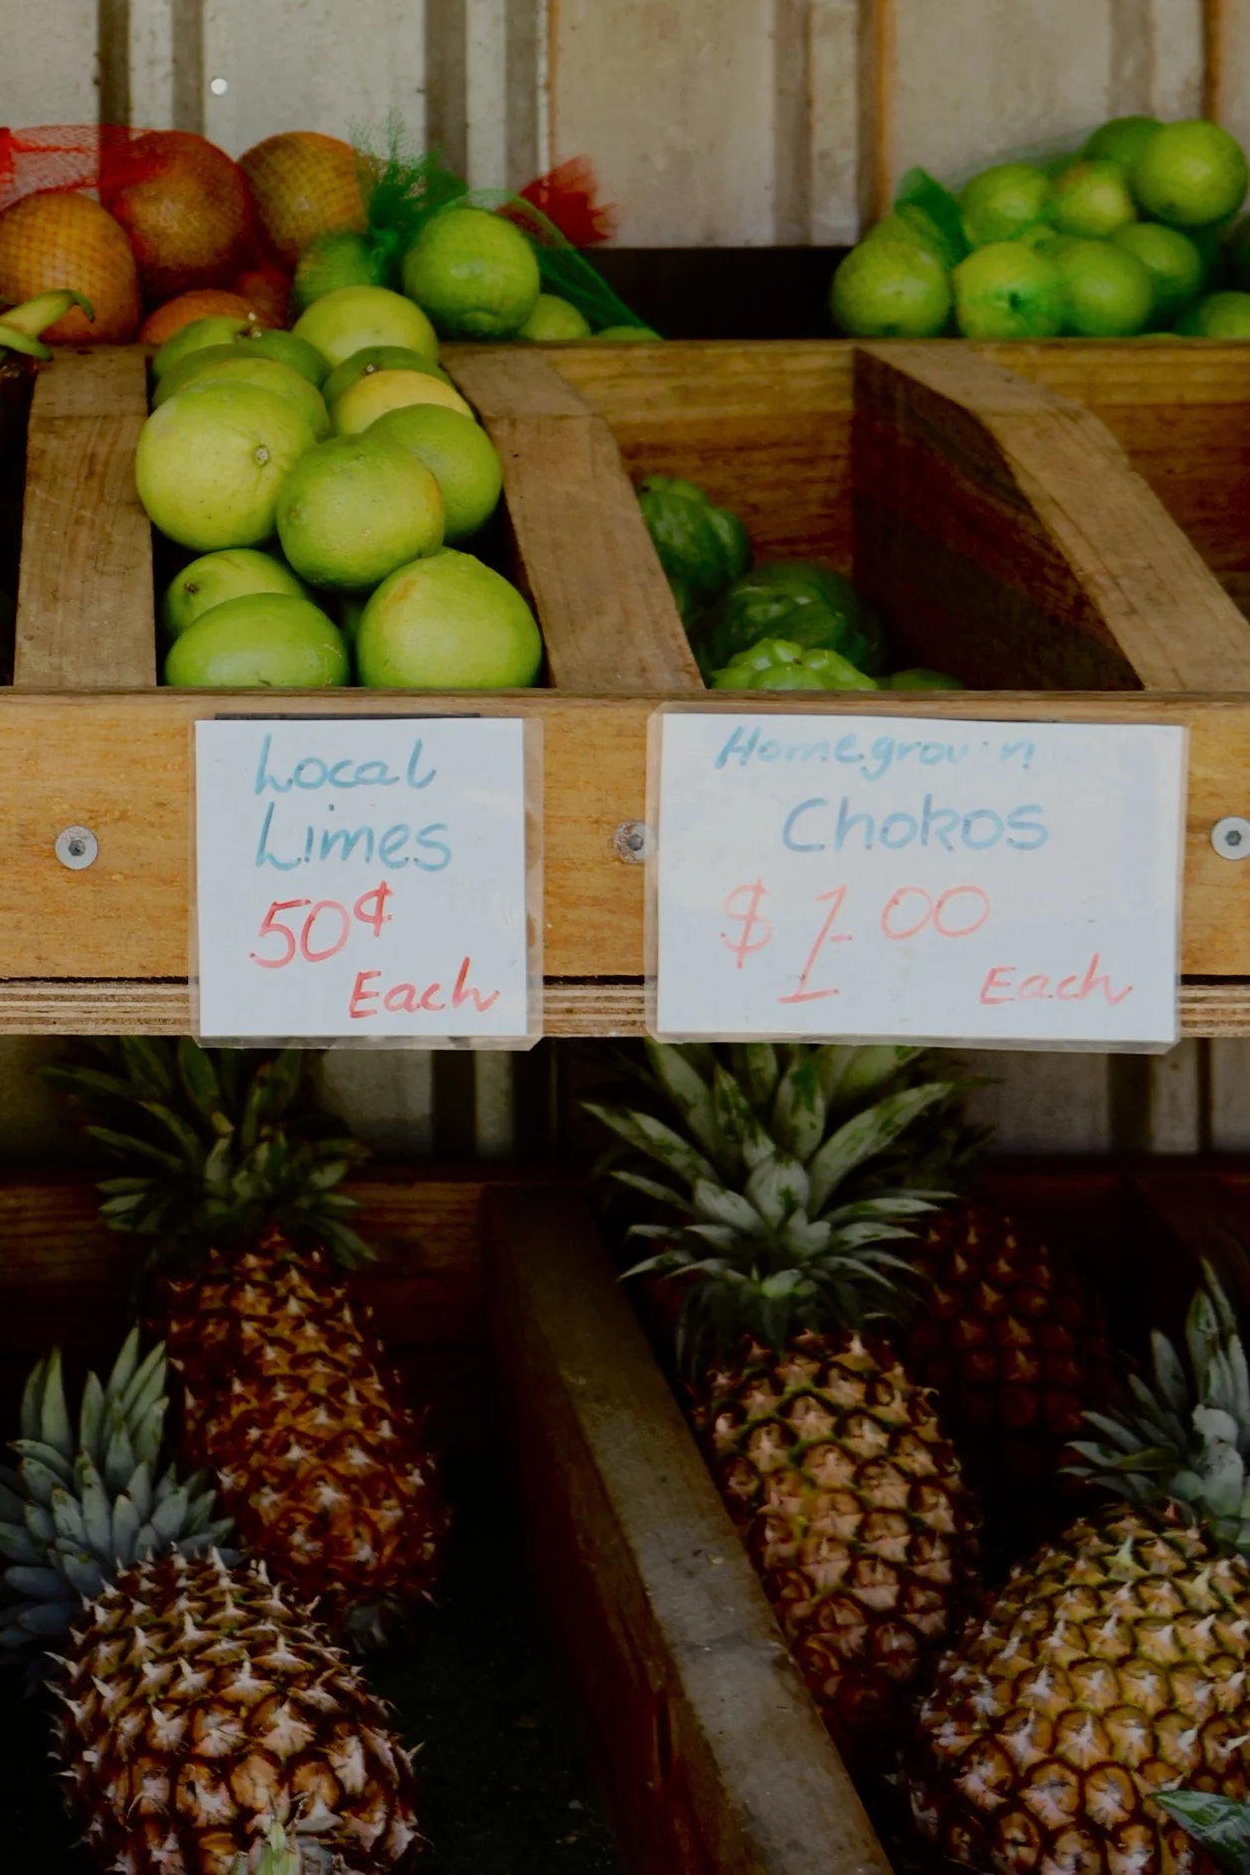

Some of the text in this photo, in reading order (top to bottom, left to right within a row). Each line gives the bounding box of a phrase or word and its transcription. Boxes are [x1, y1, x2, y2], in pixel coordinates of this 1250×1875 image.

[254, 732, 437, 796] Local
[254, 800, 452, 872] Limes
[782, 793, 1048, 852] Chokos
[348, 955, 501, 1019] Each
[979, 951, 1134, 1005] Each
